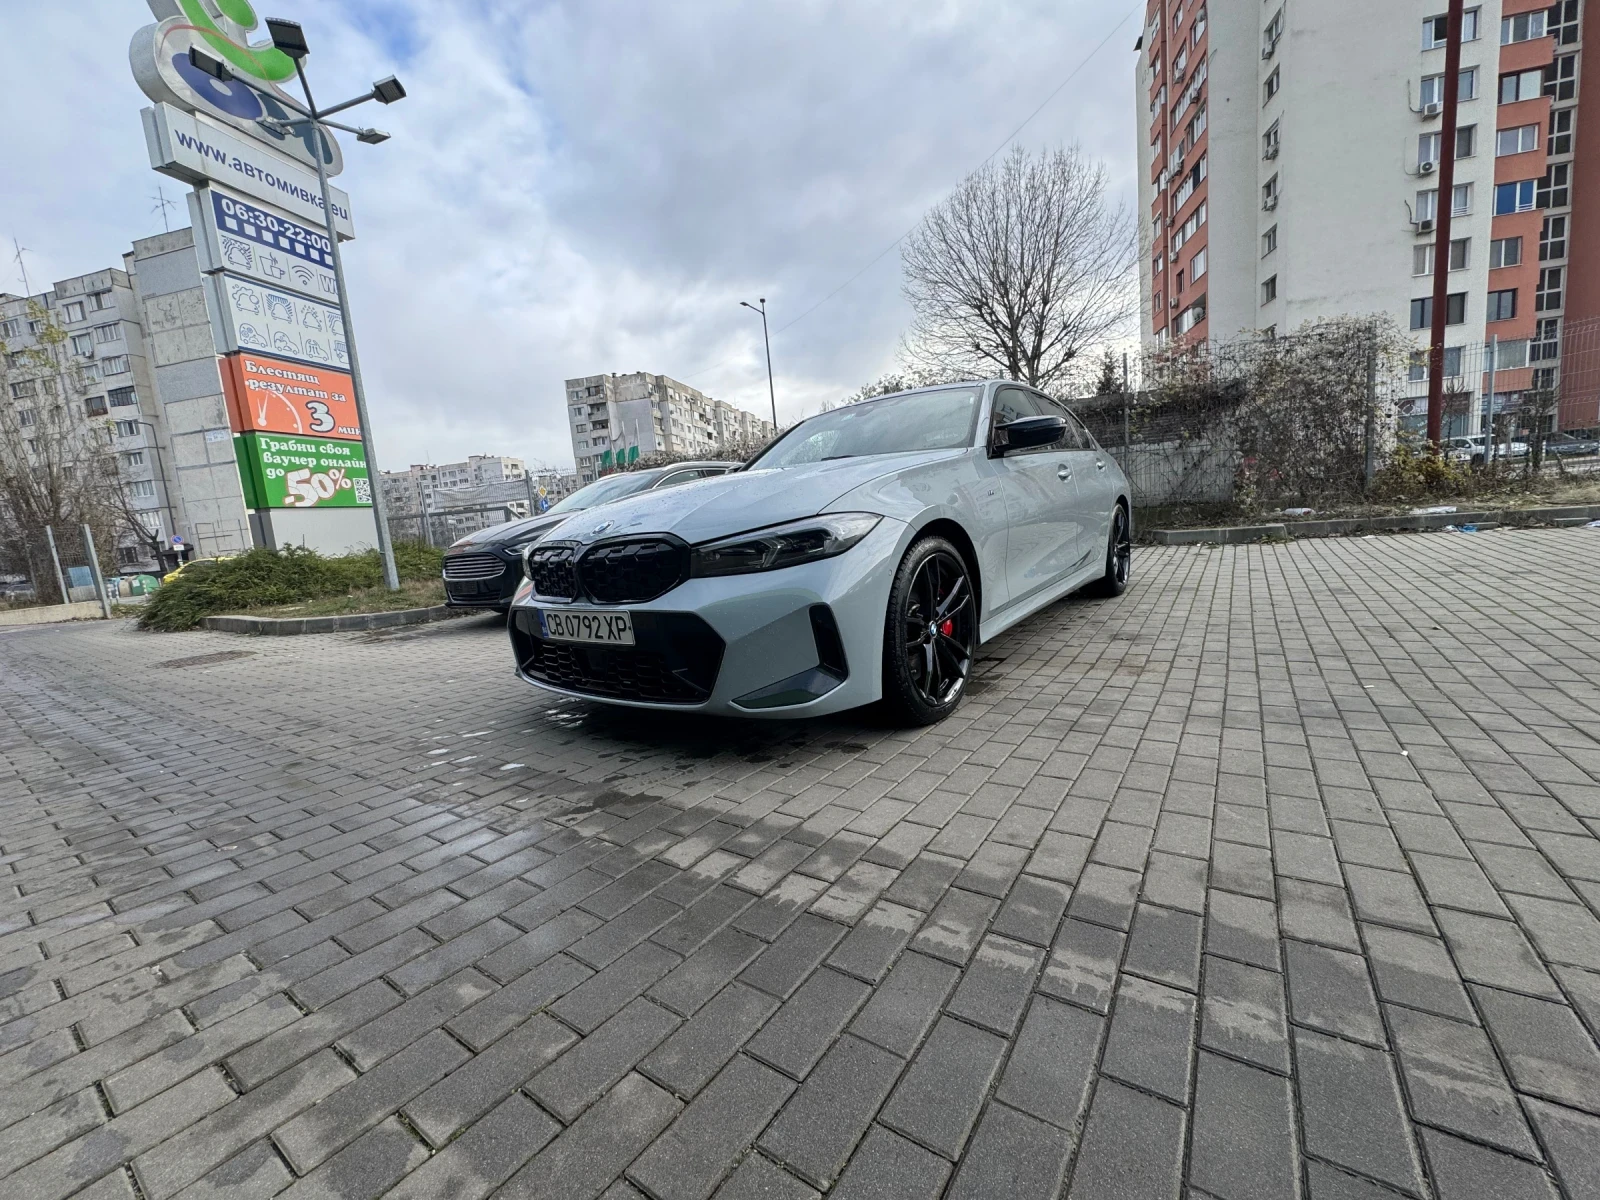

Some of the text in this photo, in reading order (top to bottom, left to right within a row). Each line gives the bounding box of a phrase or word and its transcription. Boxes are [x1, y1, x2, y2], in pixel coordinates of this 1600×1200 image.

[174, 129, 348, 220] www.автомивкаeu
[221, 198, 332, 252] 06:30-22:00
[319, 273, 338, 295] W
[244, 360, 320, 385] Блестящ
[248, 379, 347, 402] резултат за
[305, 400, 336, 433] 3
[259, 438, 351, 455] Грабни своя
[263, 452, 367, 468] ваучер онлайн
[266, 467, 352, 507] до -50%
